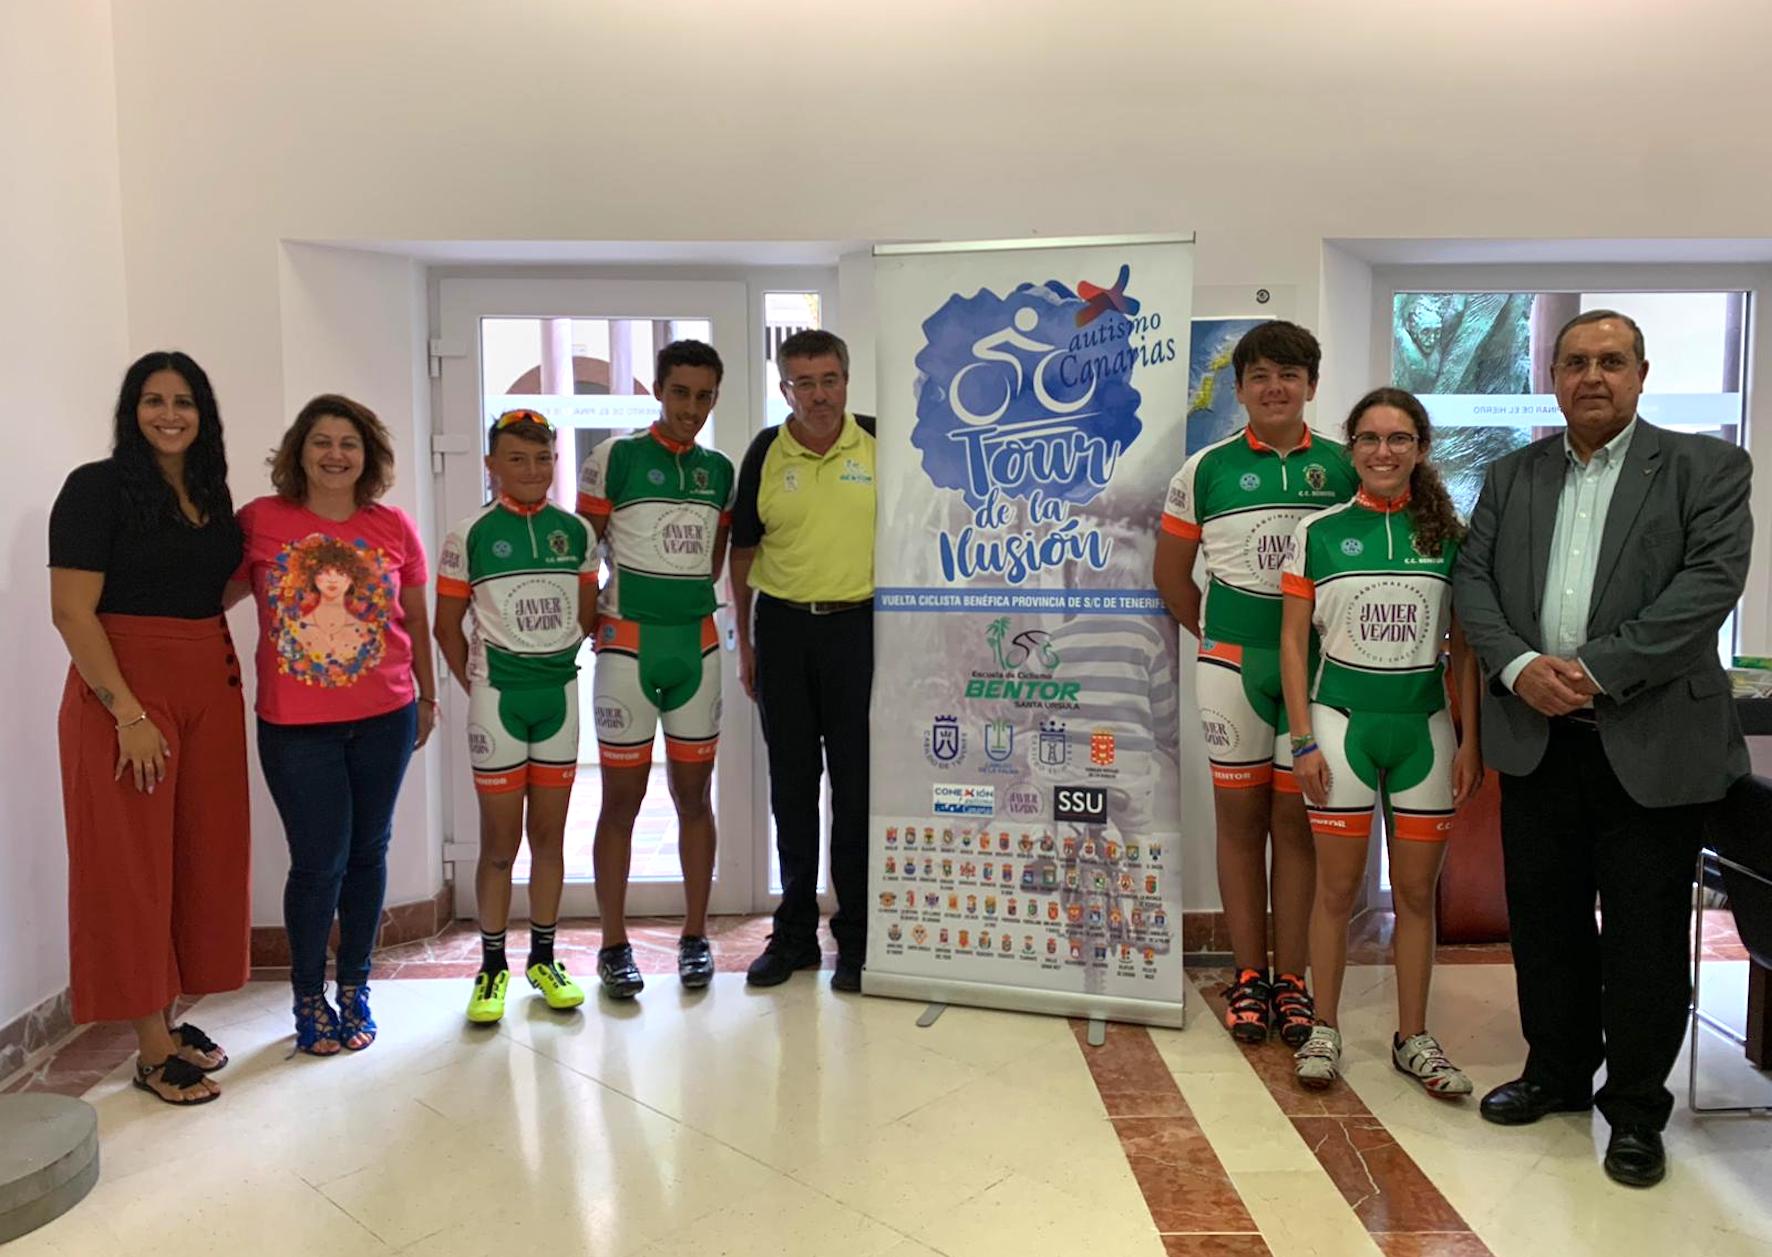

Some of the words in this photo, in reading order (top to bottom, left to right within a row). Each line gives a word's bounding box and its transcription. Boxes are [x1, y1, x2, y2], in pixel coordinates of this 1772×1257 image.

[1068, 313, 1161, 353] autismo
[1058, 334, 1176, 388] Canarias
[949, 426, 1120, 498] Tour
[974, 491, 1012, 529] de
[1030, 490, 1065, 523] la
[938, 518, 1111, 584] Ilusión
[515, 597, 562, 616] JAVIER
[882, 594, 917, 606] VUELTA
[919, 595, 961, 606] CICLISTA
[963, 594, 1010, 607] BENÉFICA
[1012, 595, 1065, 607] PROVINCIA
[1067, 597, 1082, 608] DE
[1084, 597, 1101, 608] S/C
[1103, 598, 1117, 608] DE
[1359, 603, 1418, 623] JAVIER
[1360, 623, 1418, 643] VENDIN
[963, 679, 1082, 701] BENTOR
[1058, 790, 1103, 814] SSU
